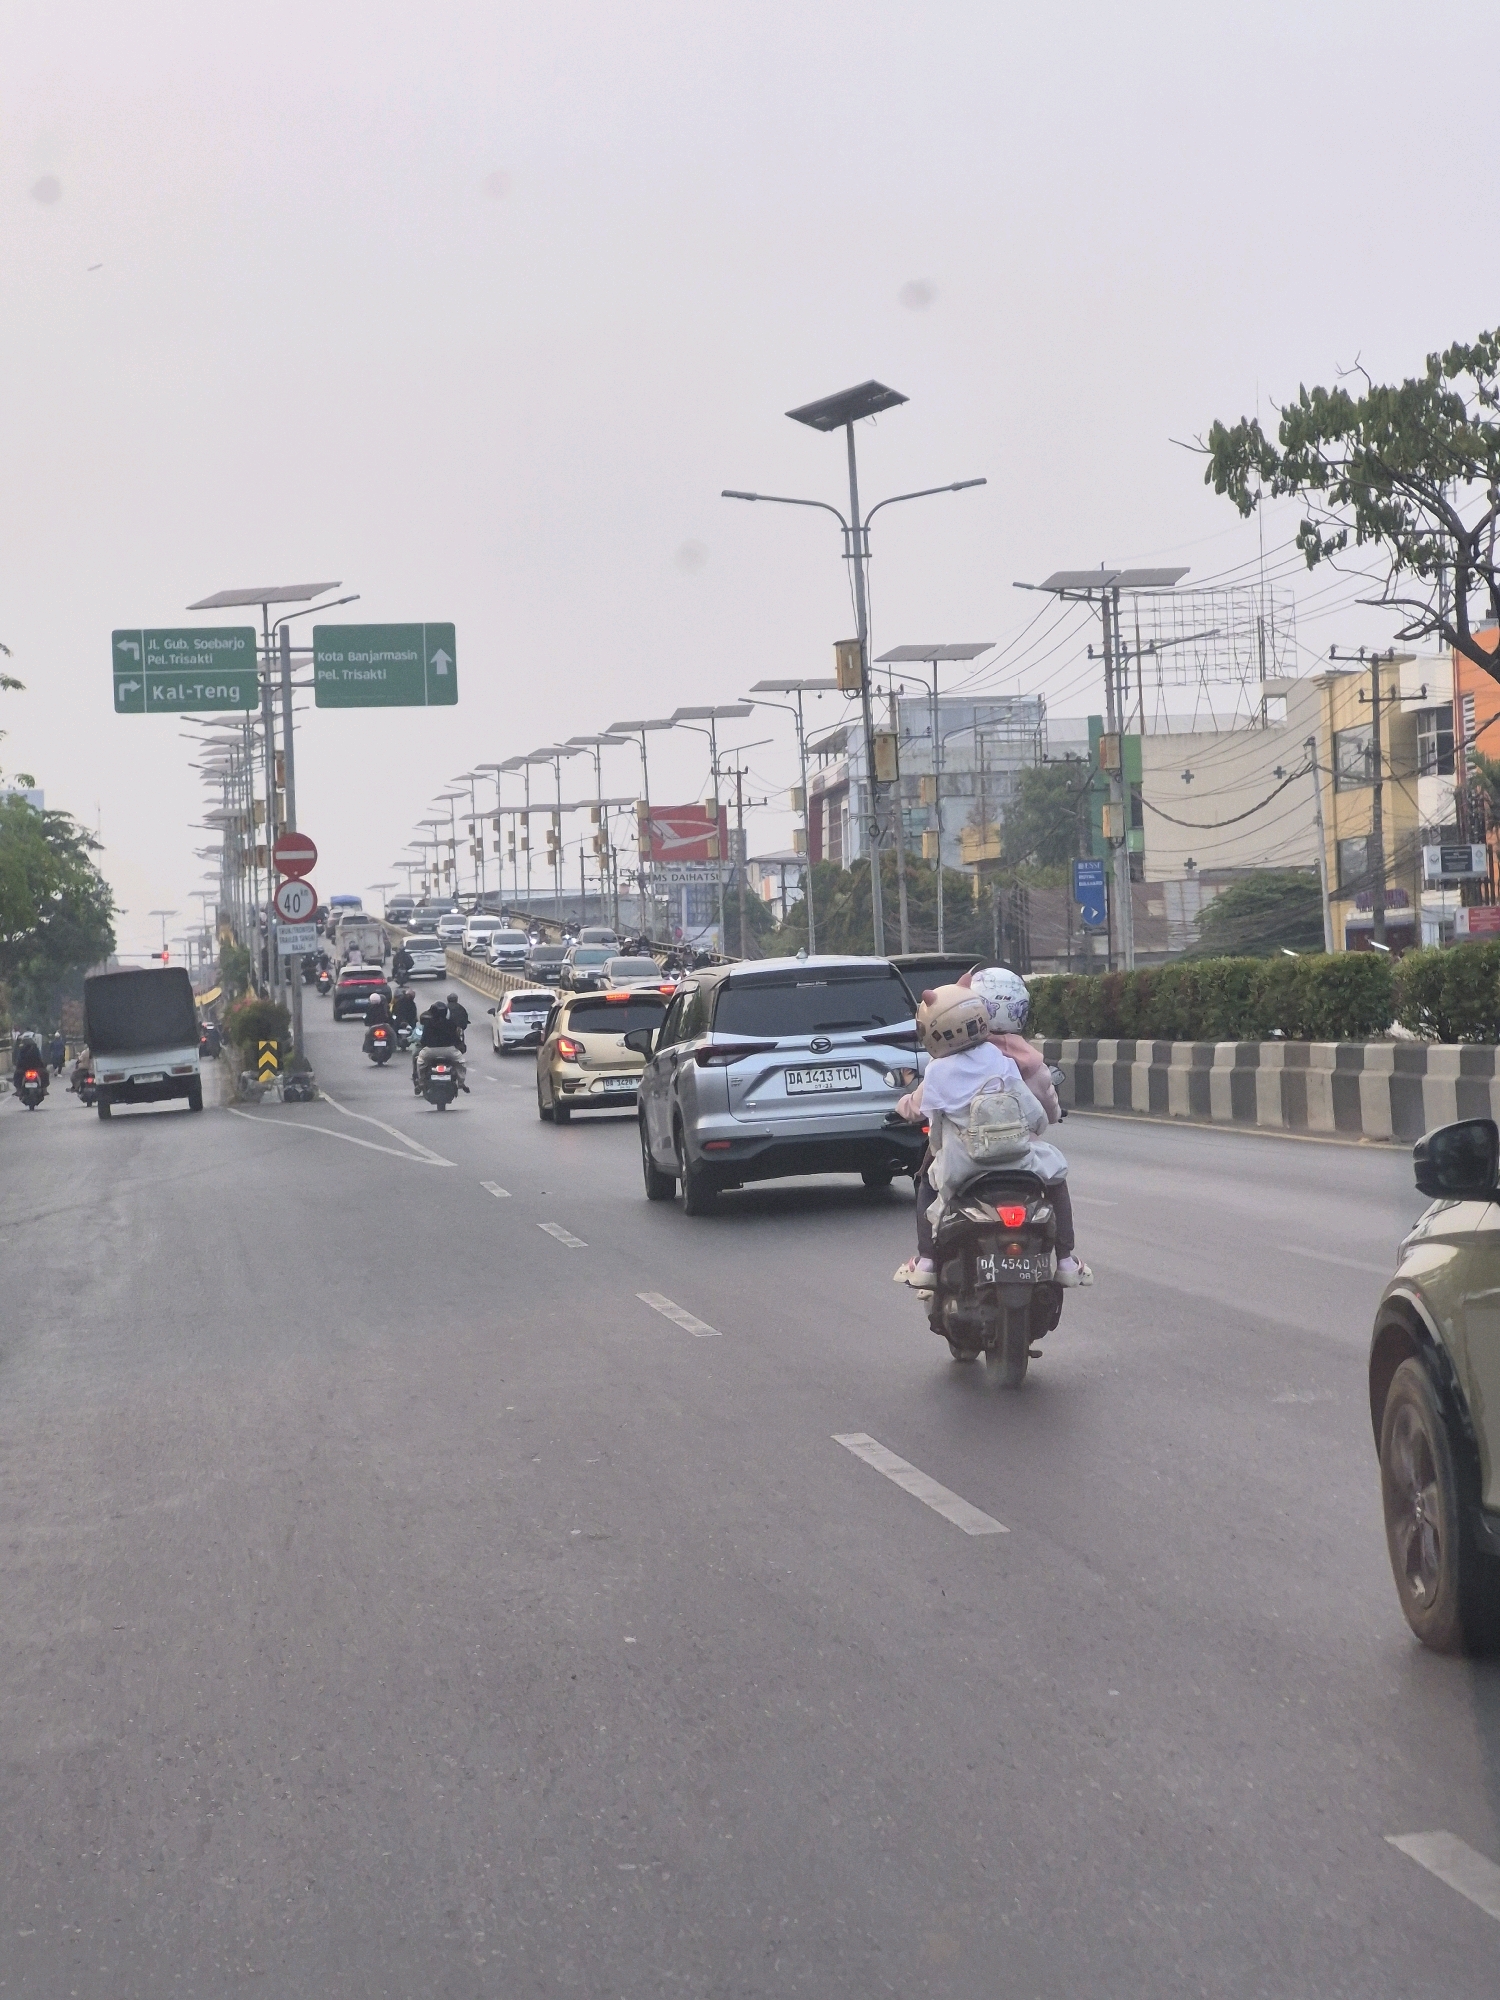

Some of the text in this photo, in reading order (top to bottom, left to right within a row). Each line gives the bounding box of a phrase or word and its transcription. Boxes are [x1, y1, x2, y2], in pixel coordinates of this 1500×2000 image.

[164, 638, 190, 650] Gub.
[193, 637, 245, 651] Soebarjo
[317, 650, 418, 664] Kota Banjarmasin
[317, 668, 387, 680] Pel. Trisakti
[152, 684, 240, 703] Kal-Teng
[284, 893, 300, 913] 40
[788, 1067, 857, 1084] DA 1413 TCW
[980, 1258, 995, 1270] DA
[1001, 1258, 1030, 1270] 4540
